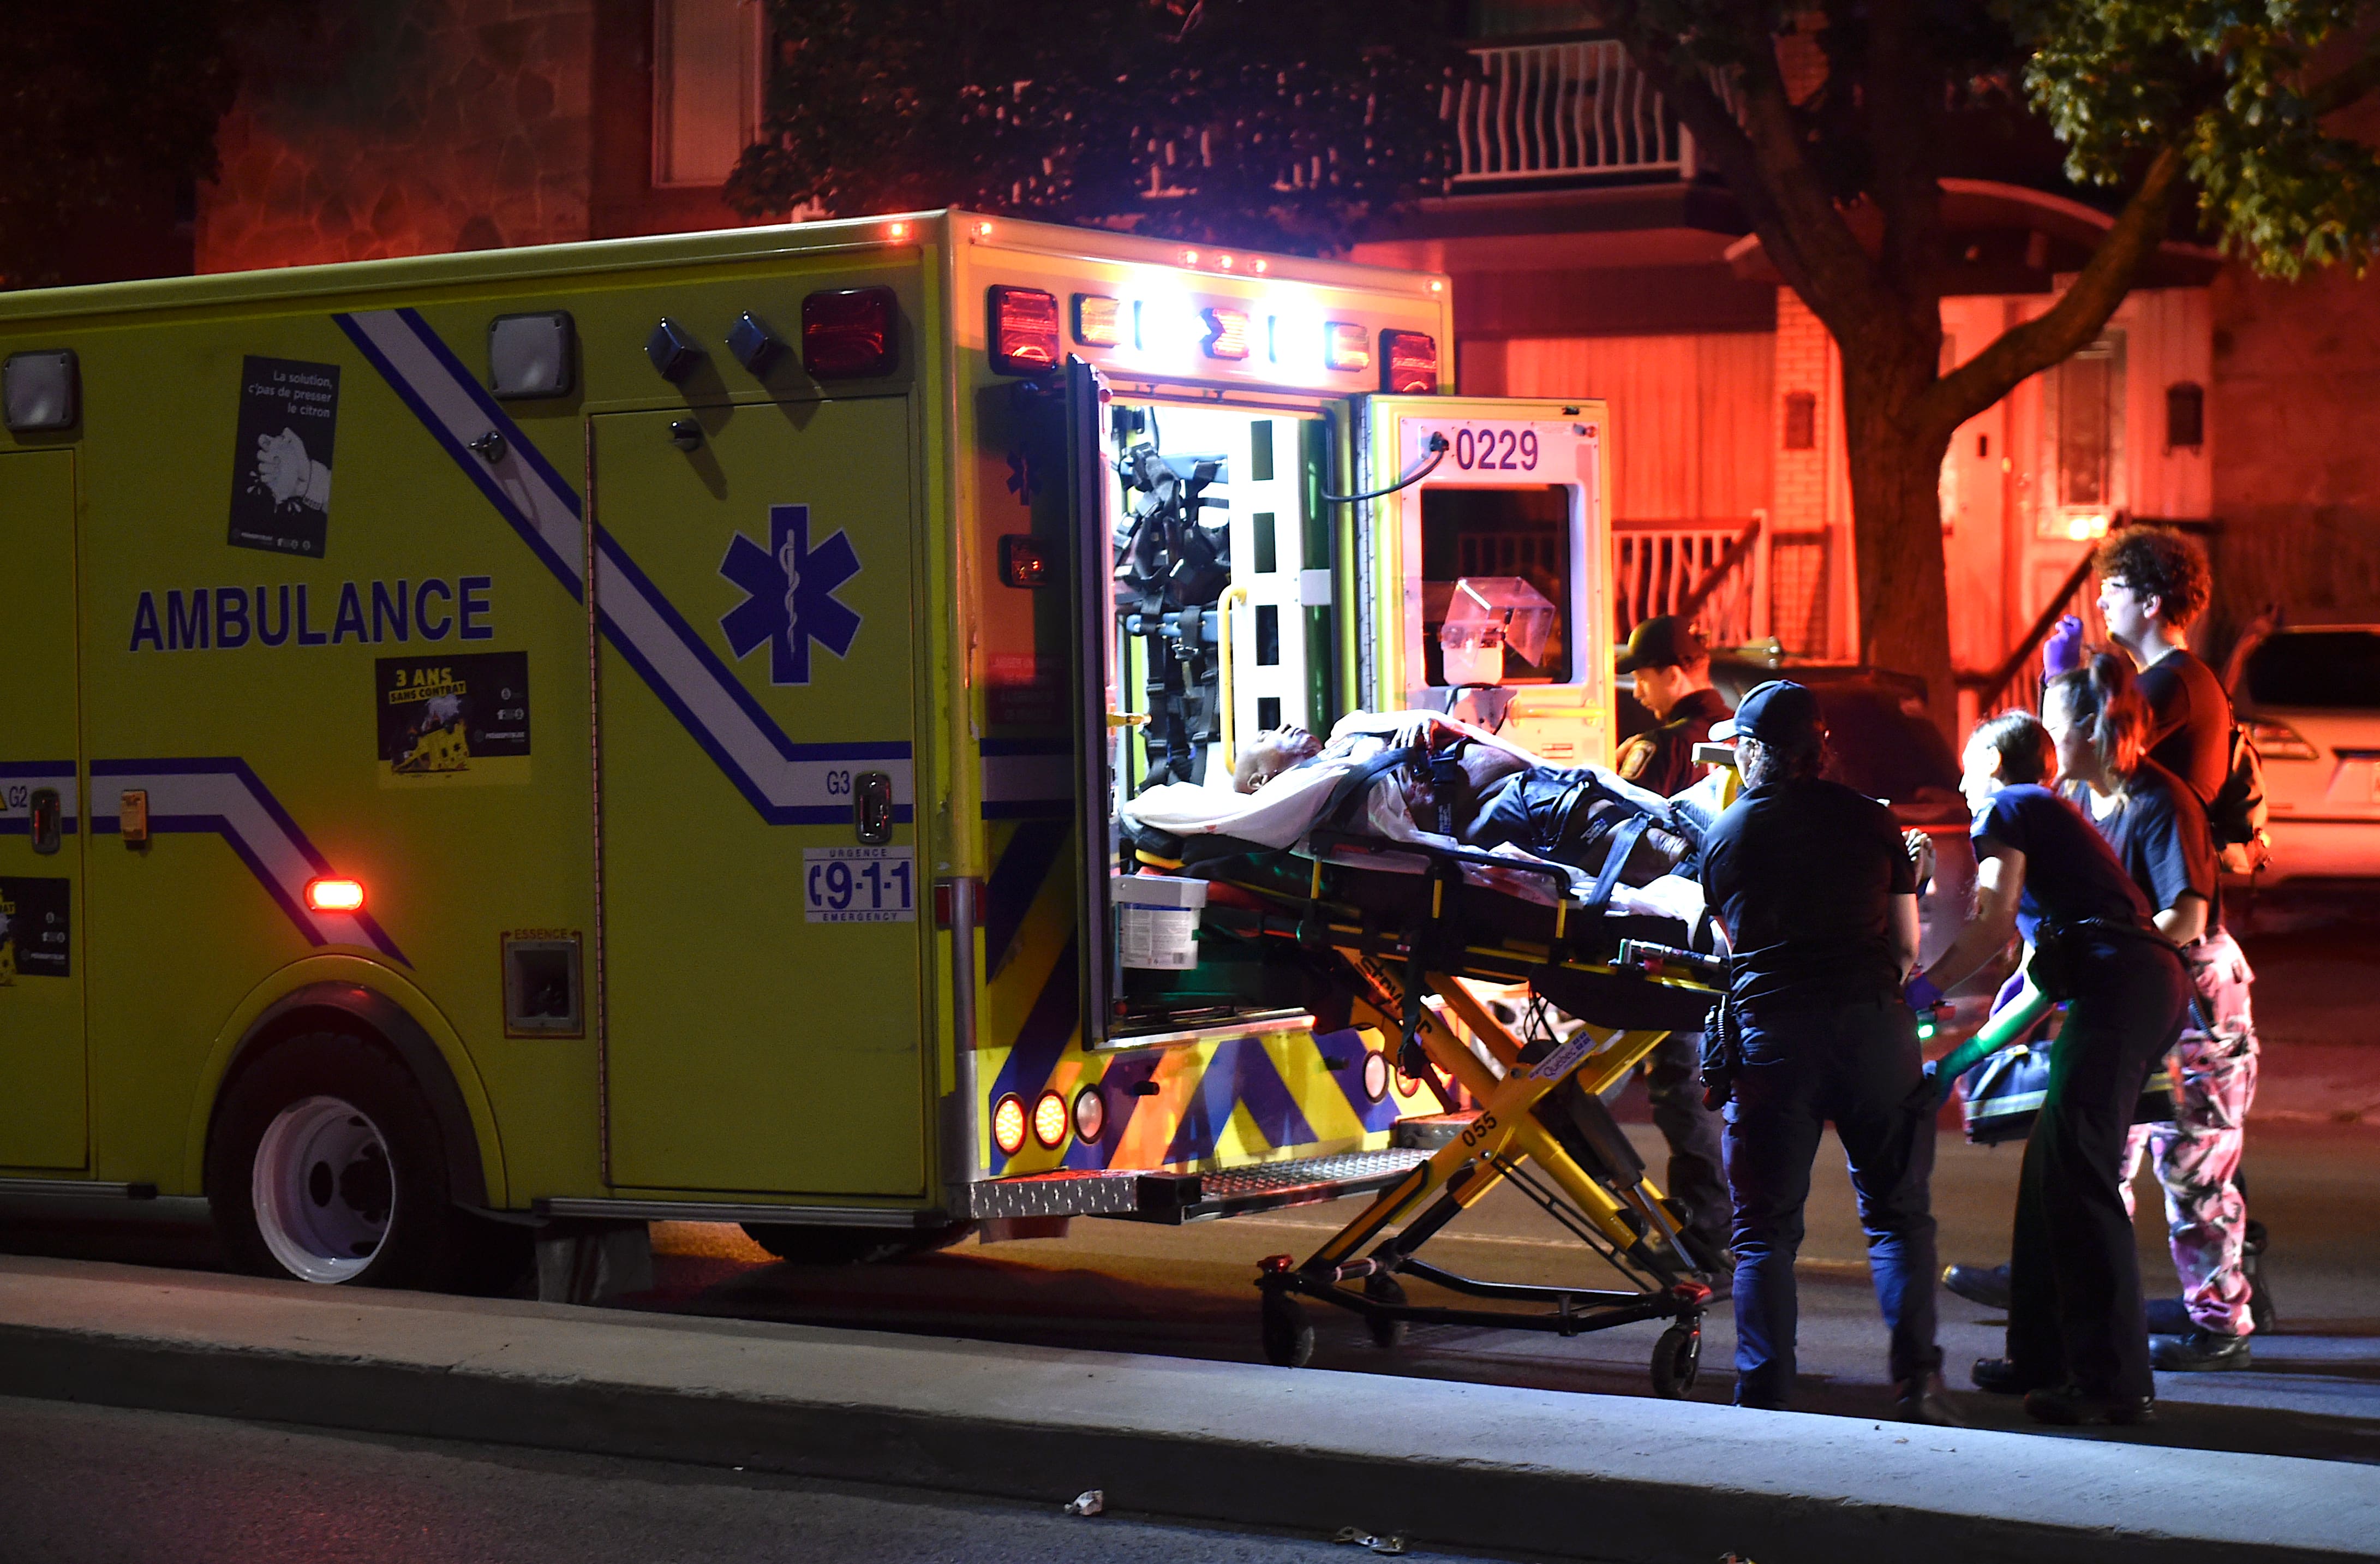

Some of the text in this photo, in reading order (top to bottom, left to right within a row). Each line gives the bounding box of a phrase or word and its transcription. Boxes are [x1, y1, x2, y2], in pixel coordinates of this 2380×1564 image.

[273, 370, 333, 389] La solution,
[248, 383, 332, 403] c'pas de presser
[288, 404, 330, 419] le citron
[1456, 428, 1539, 470] 0229
[129, 575, 495, 652] AMBULANCE
[396, 666, 453, 687] 3 ANS
[390, 683, 465, 702] SANS CONTRAT
[827, 771, 850, 795] G3
[9, 785, 27, 808] G2
[829, 848, 887, 857] URGENCE
[823, 912, 898, 921] EMERGENCY
[515, 928, 568, 939] ESSENCE
[1462, 1110, 1497, 1147] 055
